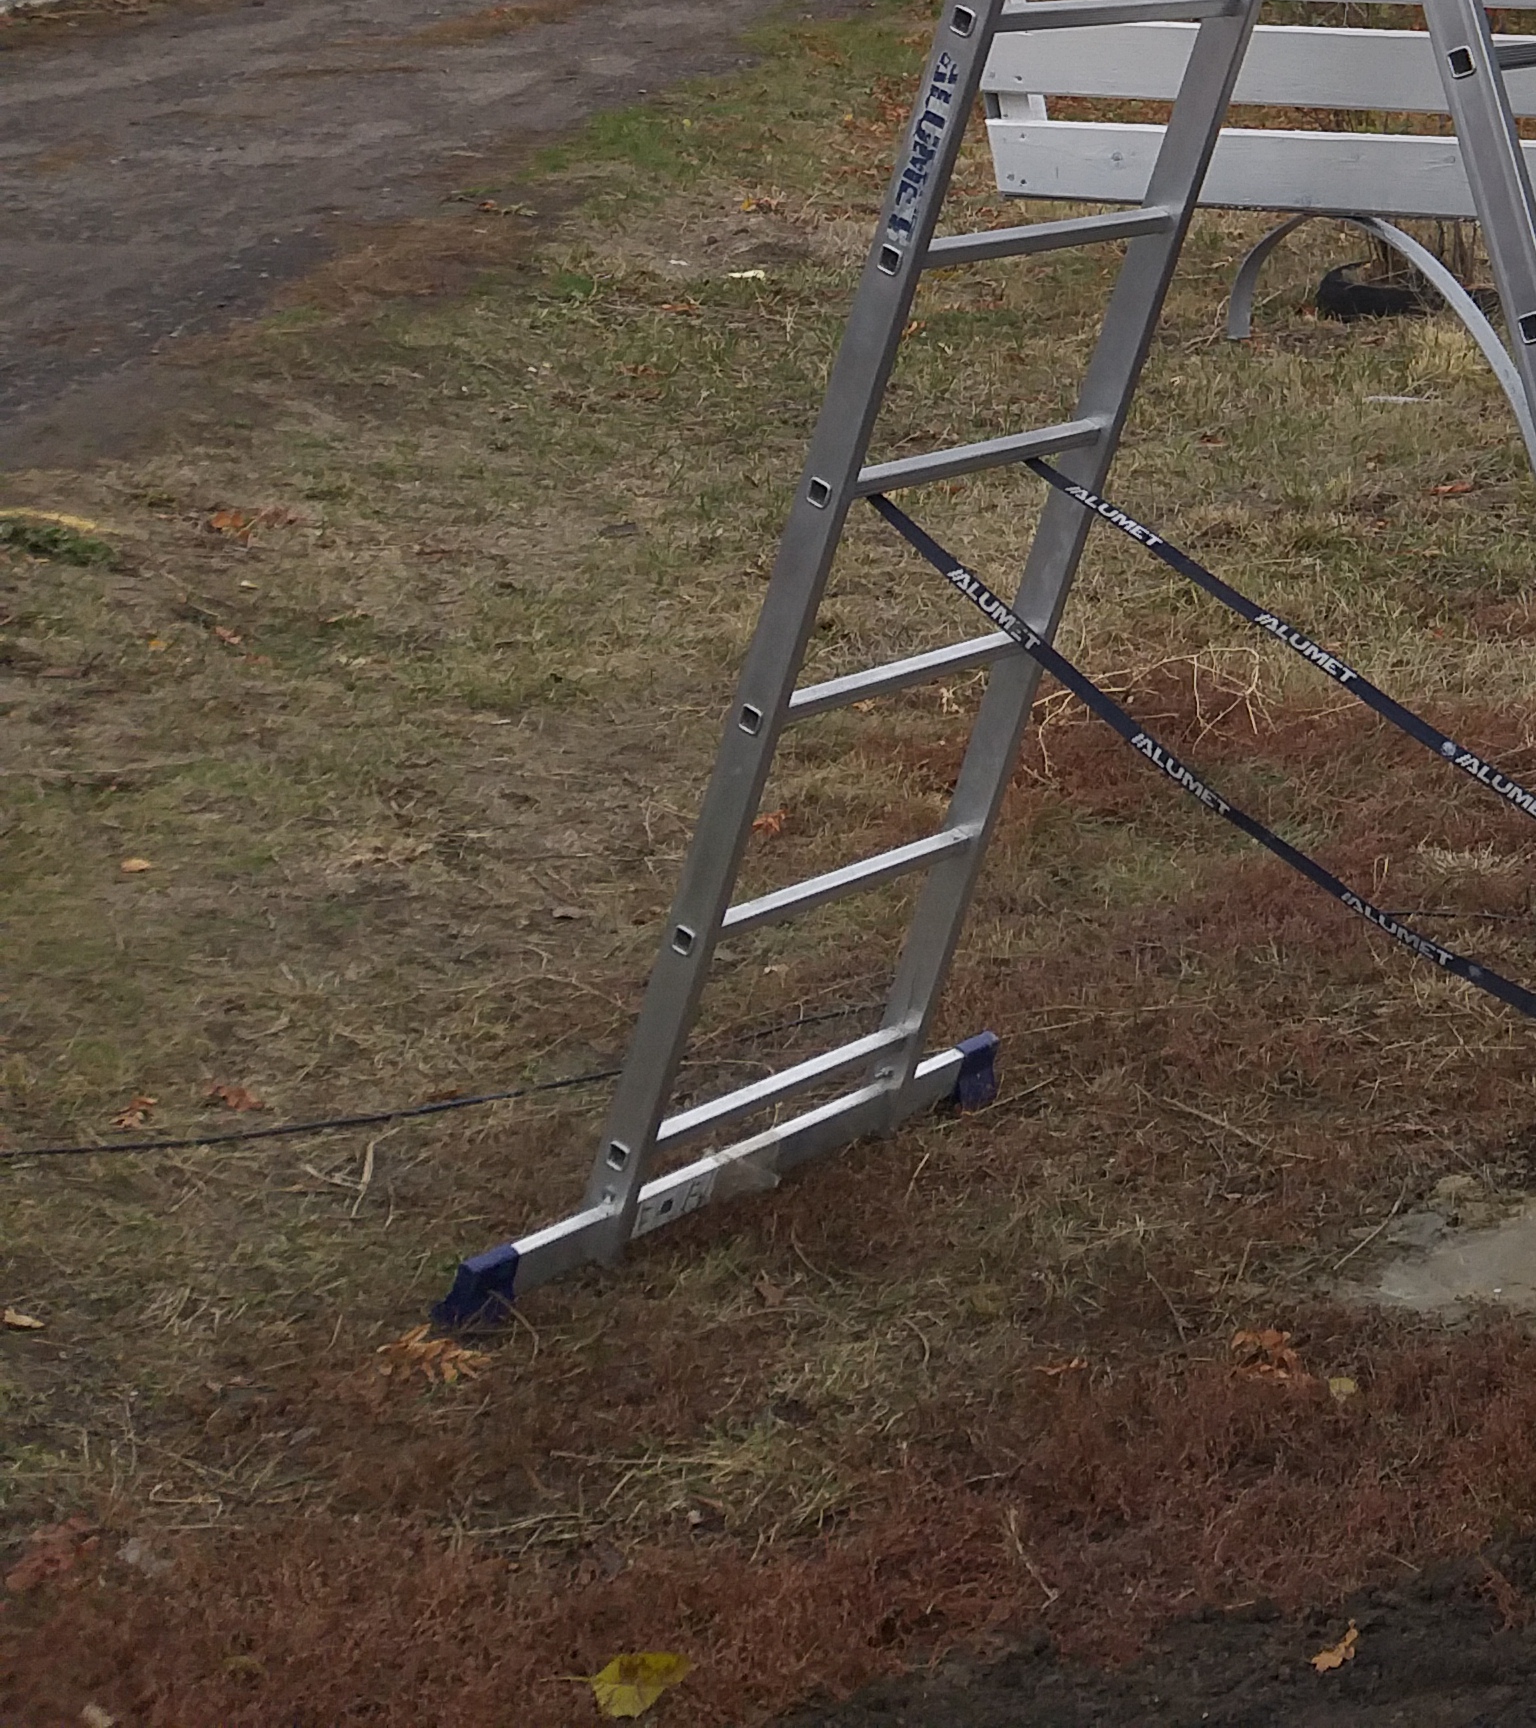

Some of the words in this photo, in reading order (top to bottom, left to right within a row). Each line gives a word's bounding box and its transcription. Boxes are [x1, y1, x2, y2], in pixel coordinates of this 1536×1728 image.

[1064, 486, 1164, 546] ALUMET
[1254, 613, 1358, 682] ALUMET
[1131, 733, 1231, 815] ALUMET
[1340, 891, 1455, 966] ALUMET
